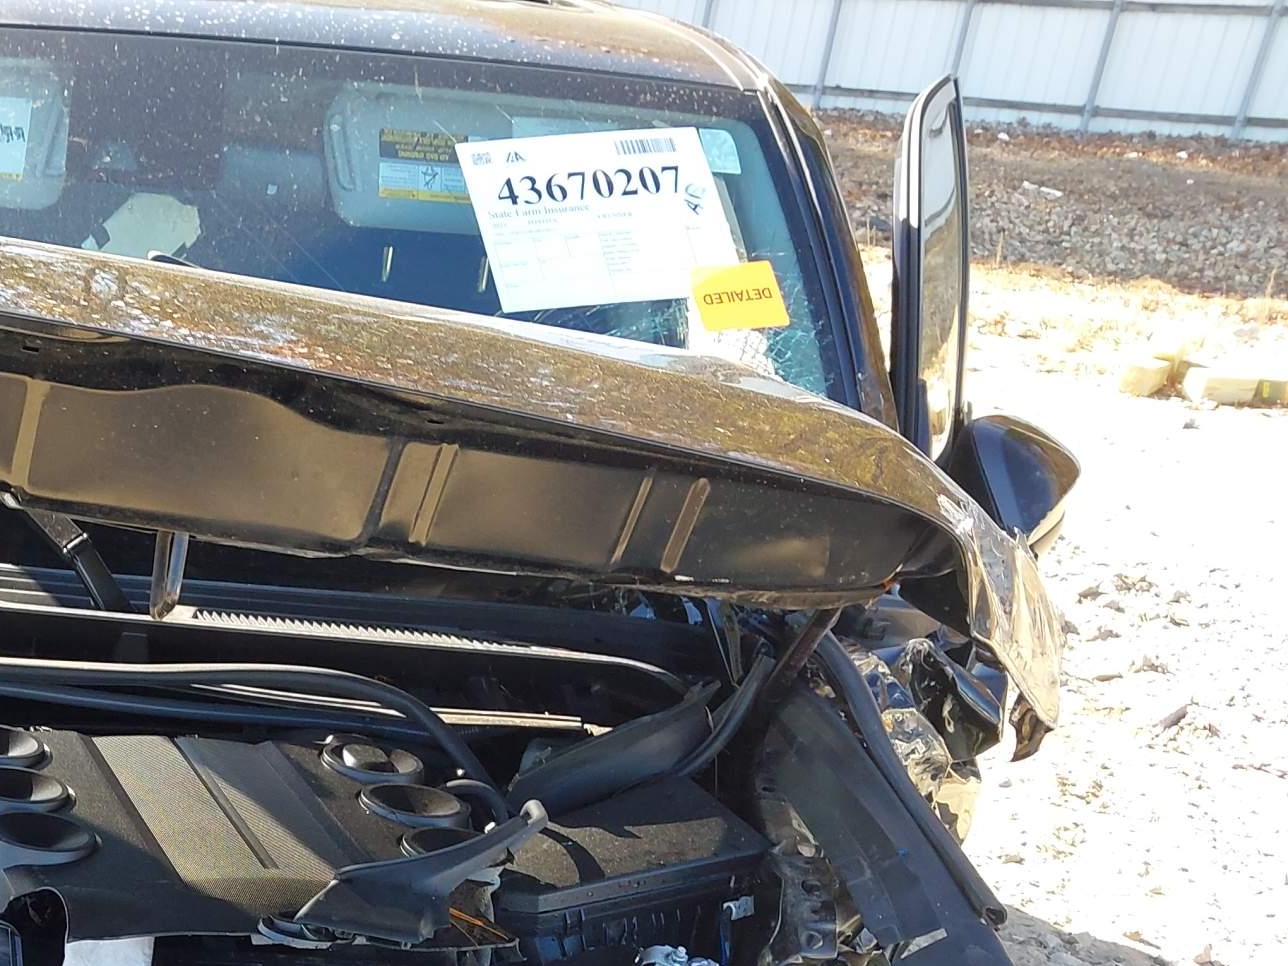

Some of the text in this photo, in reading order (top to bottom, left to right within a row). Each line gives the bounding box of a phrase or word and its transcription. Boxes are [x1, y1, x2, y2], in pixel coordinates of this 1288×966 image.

[497, 165, 680, 206] 43670207
[487, 210, 512, 219] State
[514, 208, 542, 217] Farm
[703, 287, 773, 305] DETAILED
